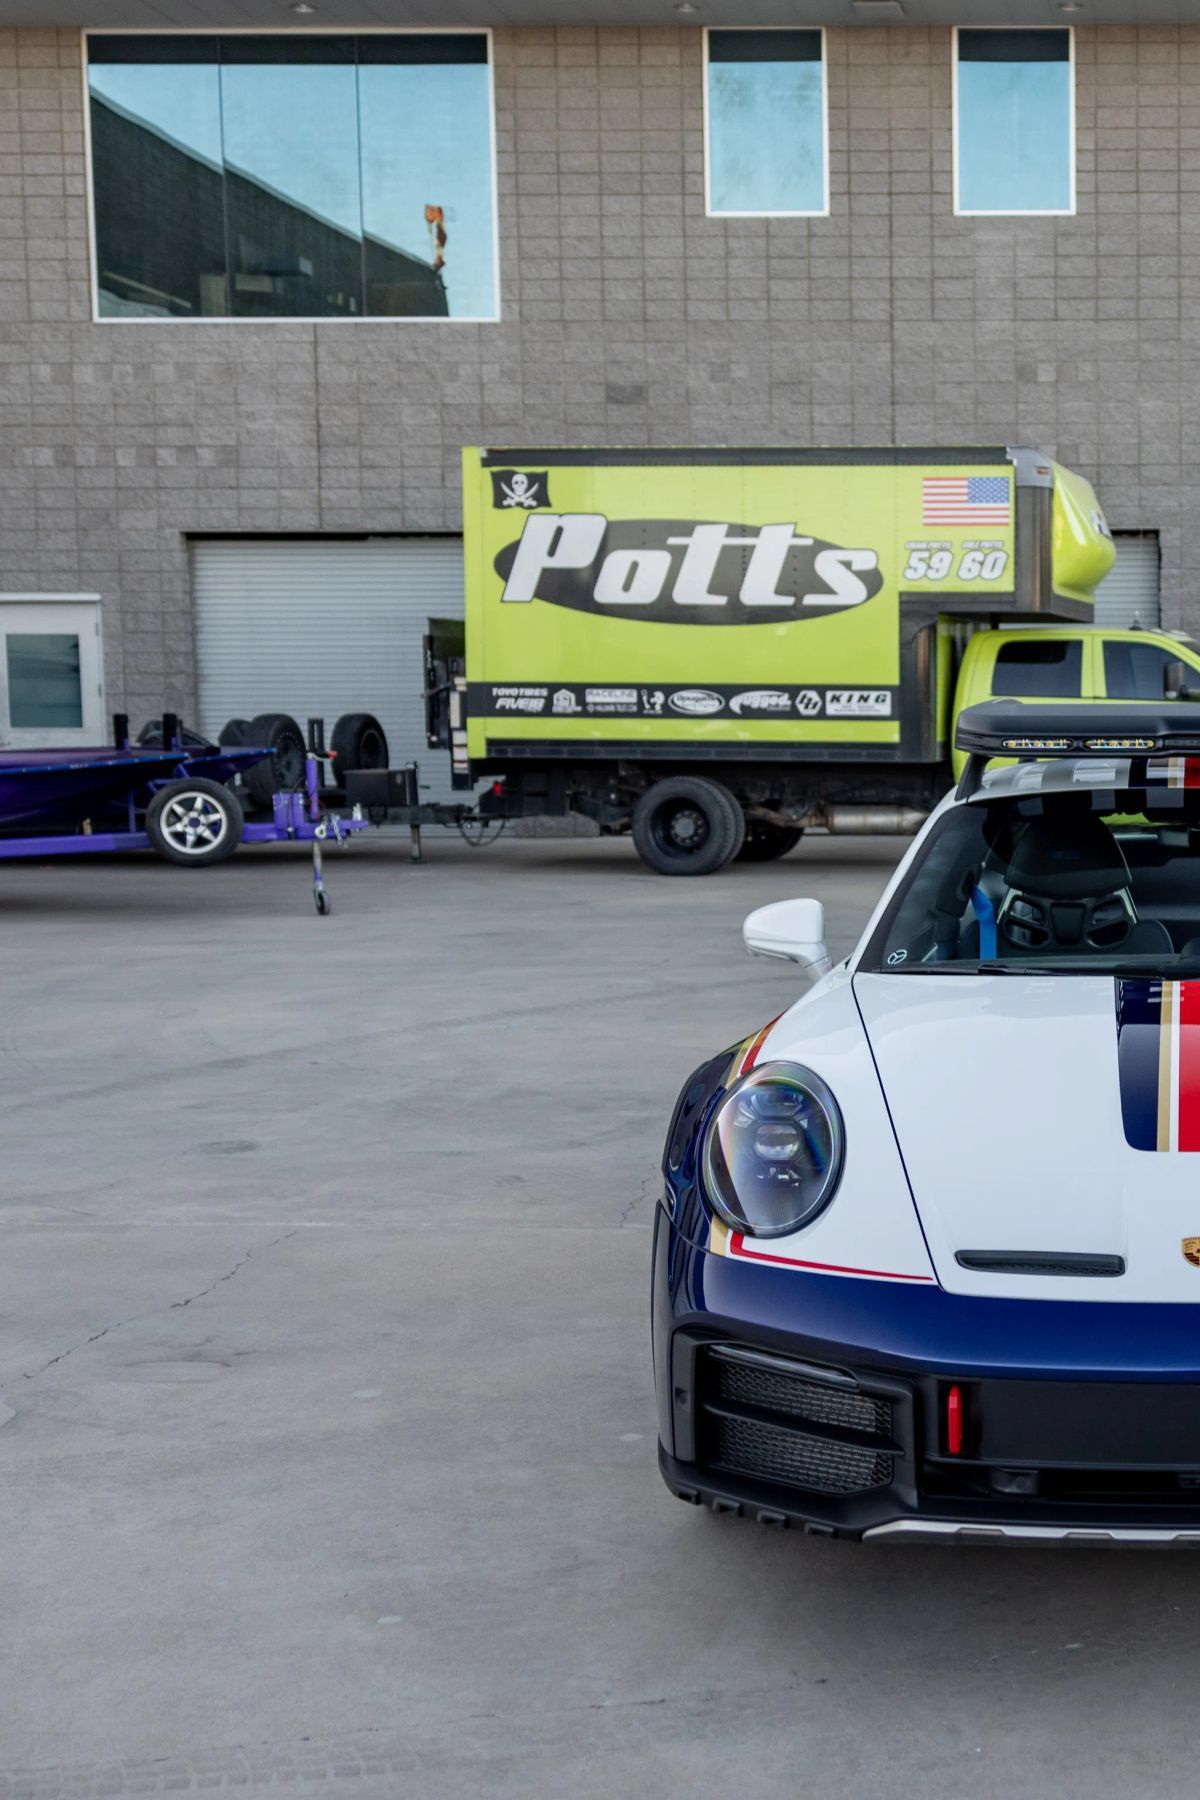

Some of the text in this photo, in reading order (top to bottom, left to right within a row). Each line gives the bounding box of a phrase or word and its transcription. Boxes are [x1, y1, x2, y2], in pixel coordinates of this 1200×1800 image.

[502, 513, 878, 606] Potts
[903, 550, 953, 580] 59
[958, 550, 1009, 580] 60
[492, 688, 549, 697] TOYO TIRES
[830, 693, 888, 704] KING
